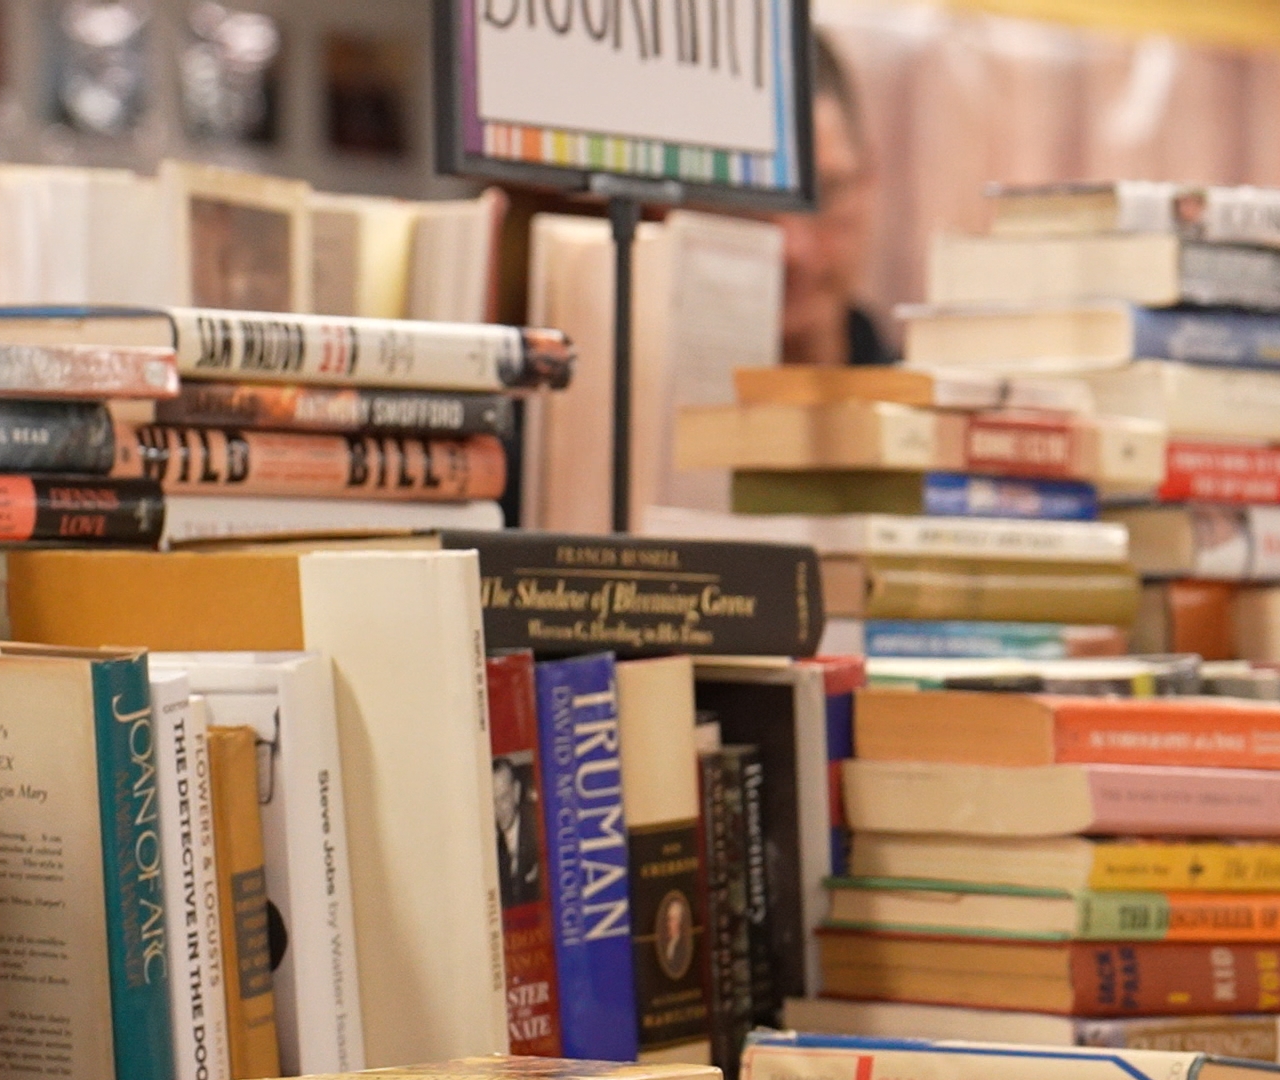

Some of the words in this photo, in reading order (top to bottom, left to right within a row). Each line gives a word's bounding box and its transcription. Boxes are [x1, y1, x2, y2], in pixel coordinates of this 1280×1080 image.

[138, 427, 250, 482] WILD
[347, 437, 443, 488] BILL
[60, 514, 107, 536] LOVE
[113, 696, 158, 826] JOAN
[18, 782, 48, 803] Mary
[572, 676, 630, 942] TRUMAN
[136, 831, 162, 884] OF
[139, 902, 168, 984] ARC
